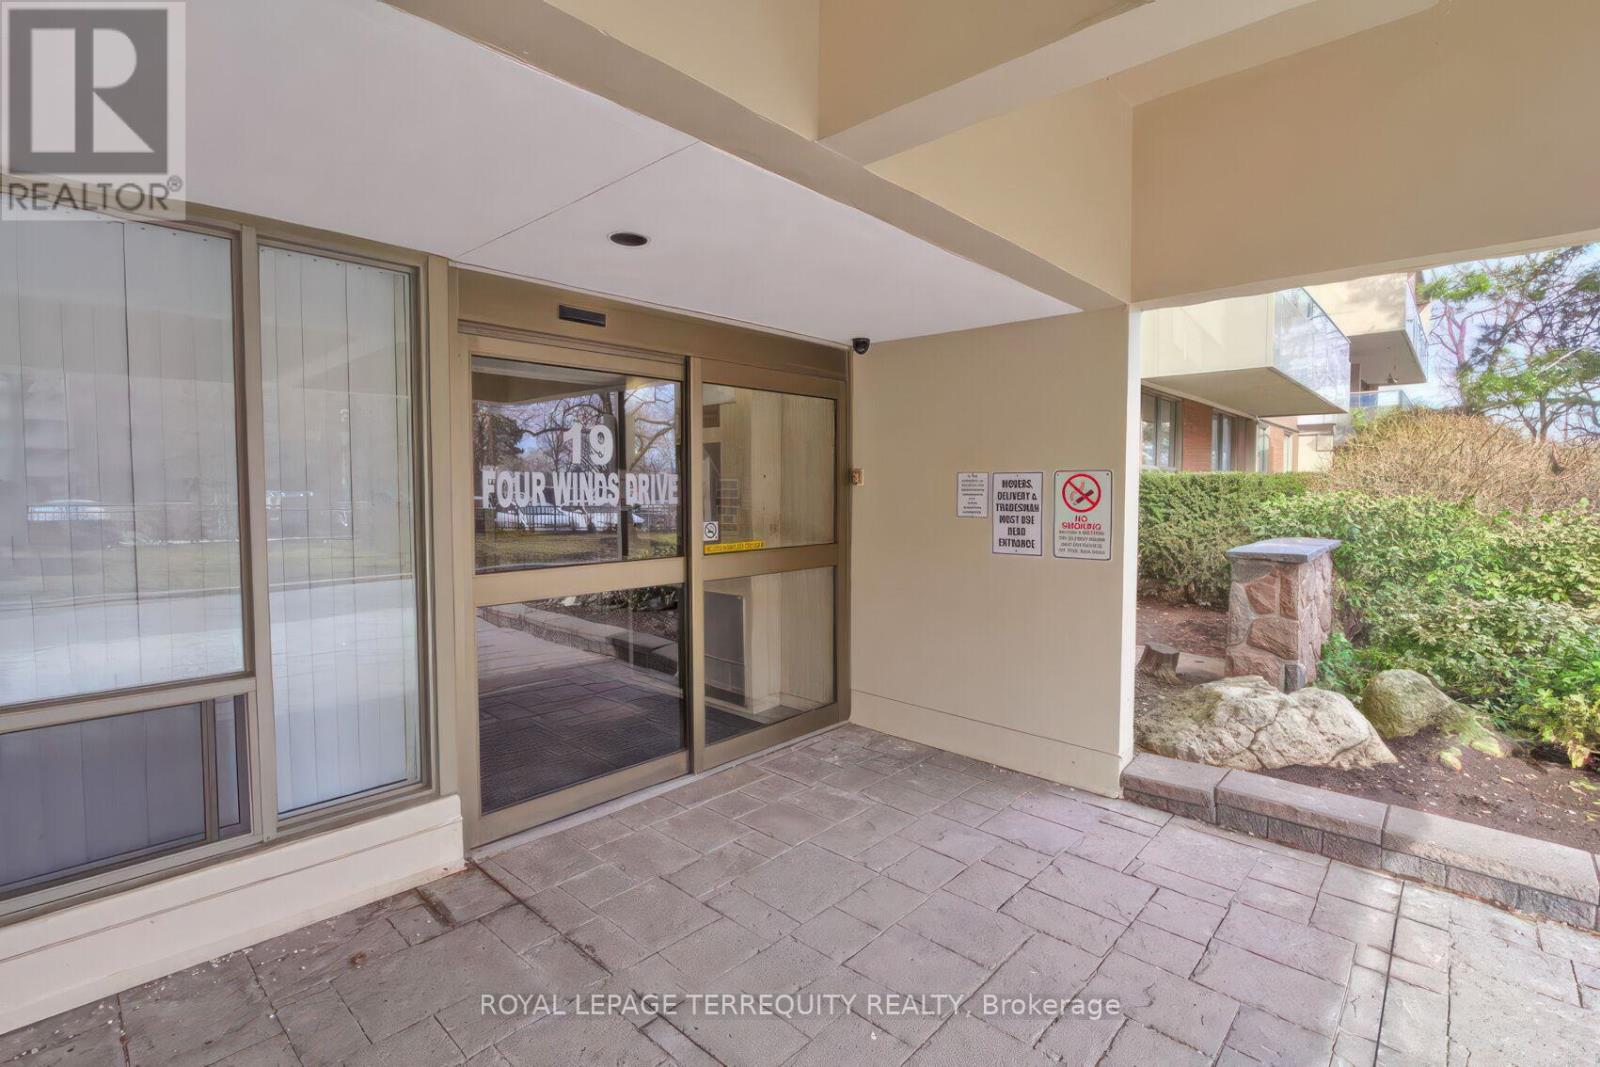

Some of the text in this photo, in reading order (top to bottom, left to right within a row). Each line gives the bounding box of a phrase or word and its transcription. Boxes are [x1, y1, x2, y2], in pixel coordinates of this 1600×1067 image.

[562, 421, 615, 466] 19
[481, 470, 679, 508] FOUR WINDS DRIVE
[997, 491, 1031, 501] DELIVERY
[999, 515, 1035, 525] MUST USE
[1061, 521, 1102, 531] SMOKING
[998, 538, 1036, 548] ENTRANCE
